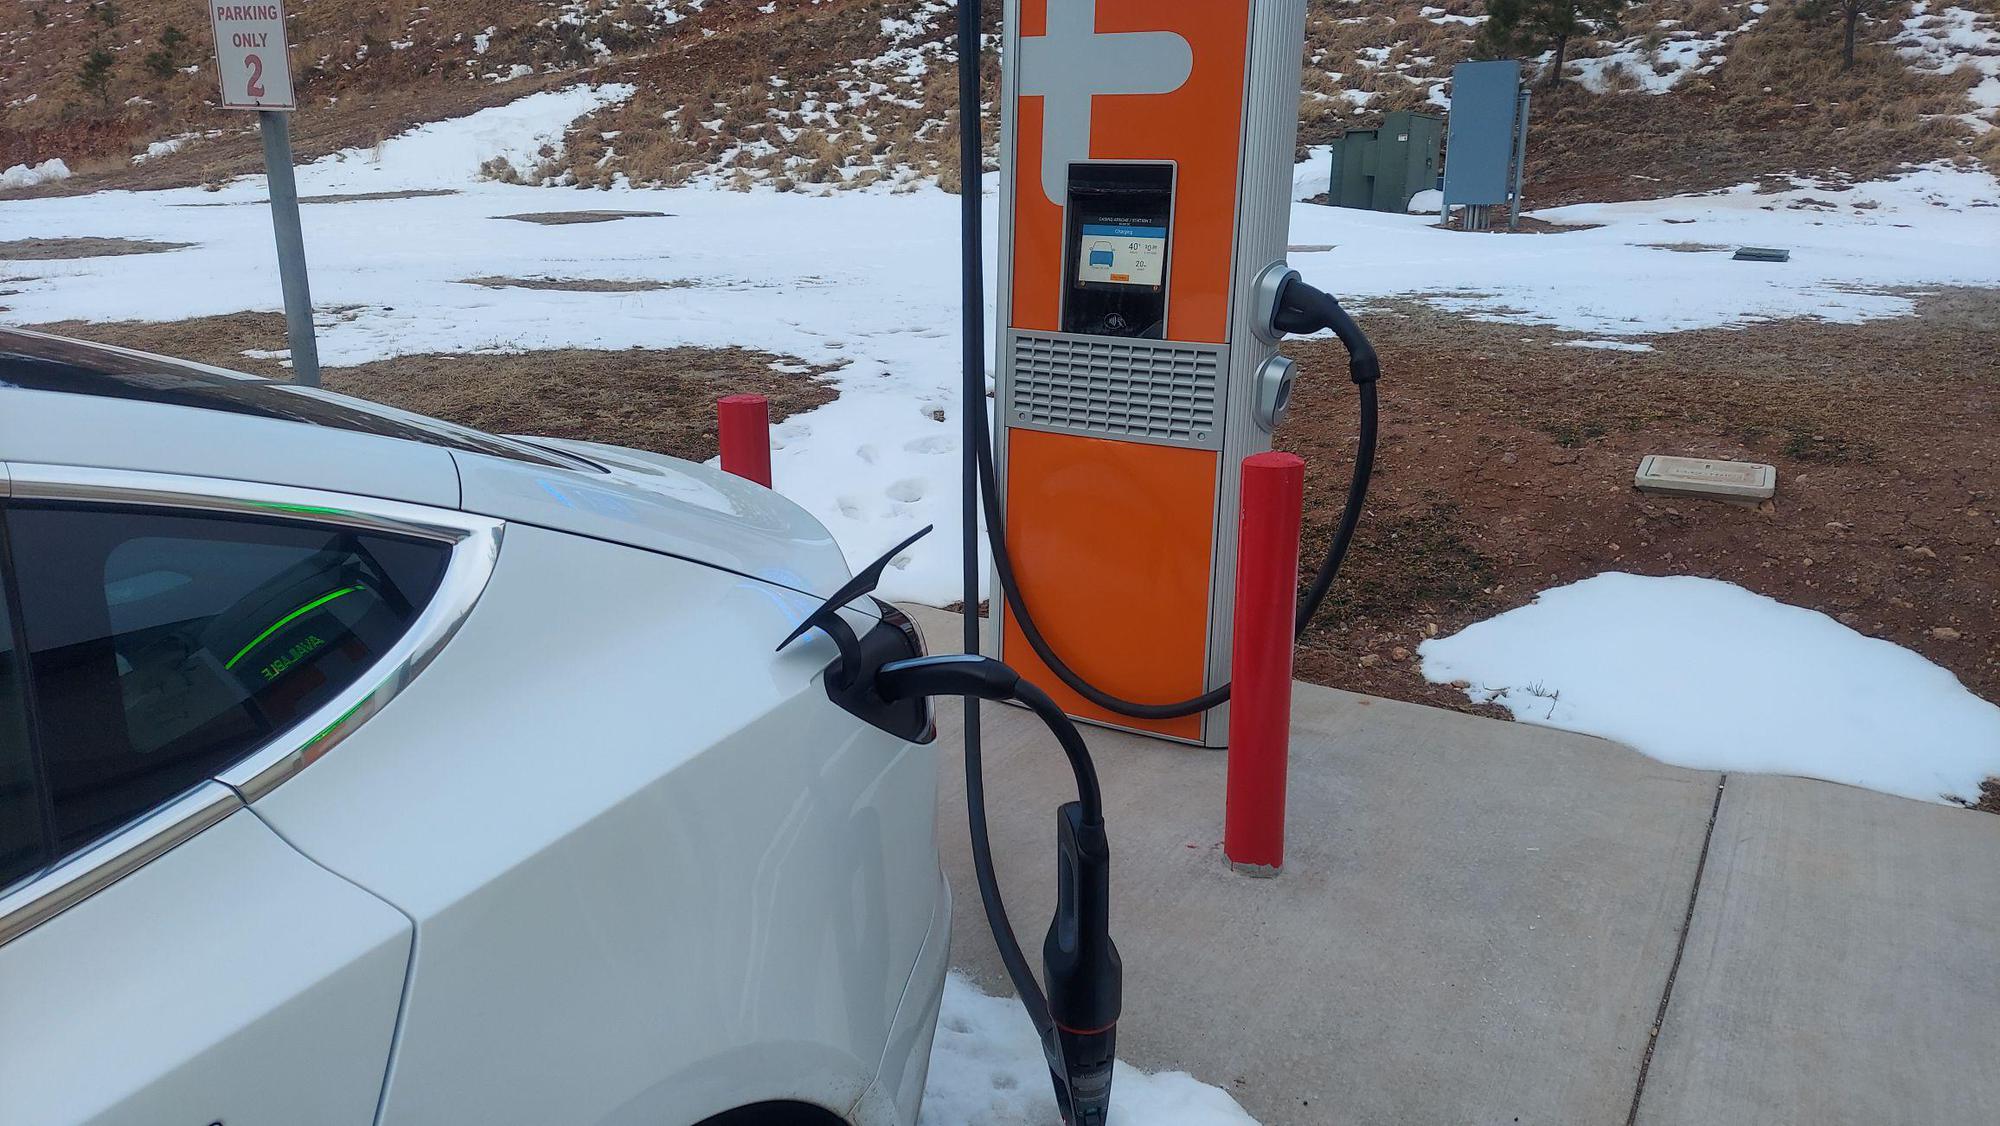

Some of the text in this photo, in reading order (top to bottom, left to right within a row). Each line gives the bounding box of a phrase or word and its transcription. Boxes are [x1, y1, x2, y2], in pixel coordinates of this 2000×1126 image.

[217, 5, 278, 20] PARKING
[232, 33, 268, 48] ONLY
[244, 54, 265, 97] 2
